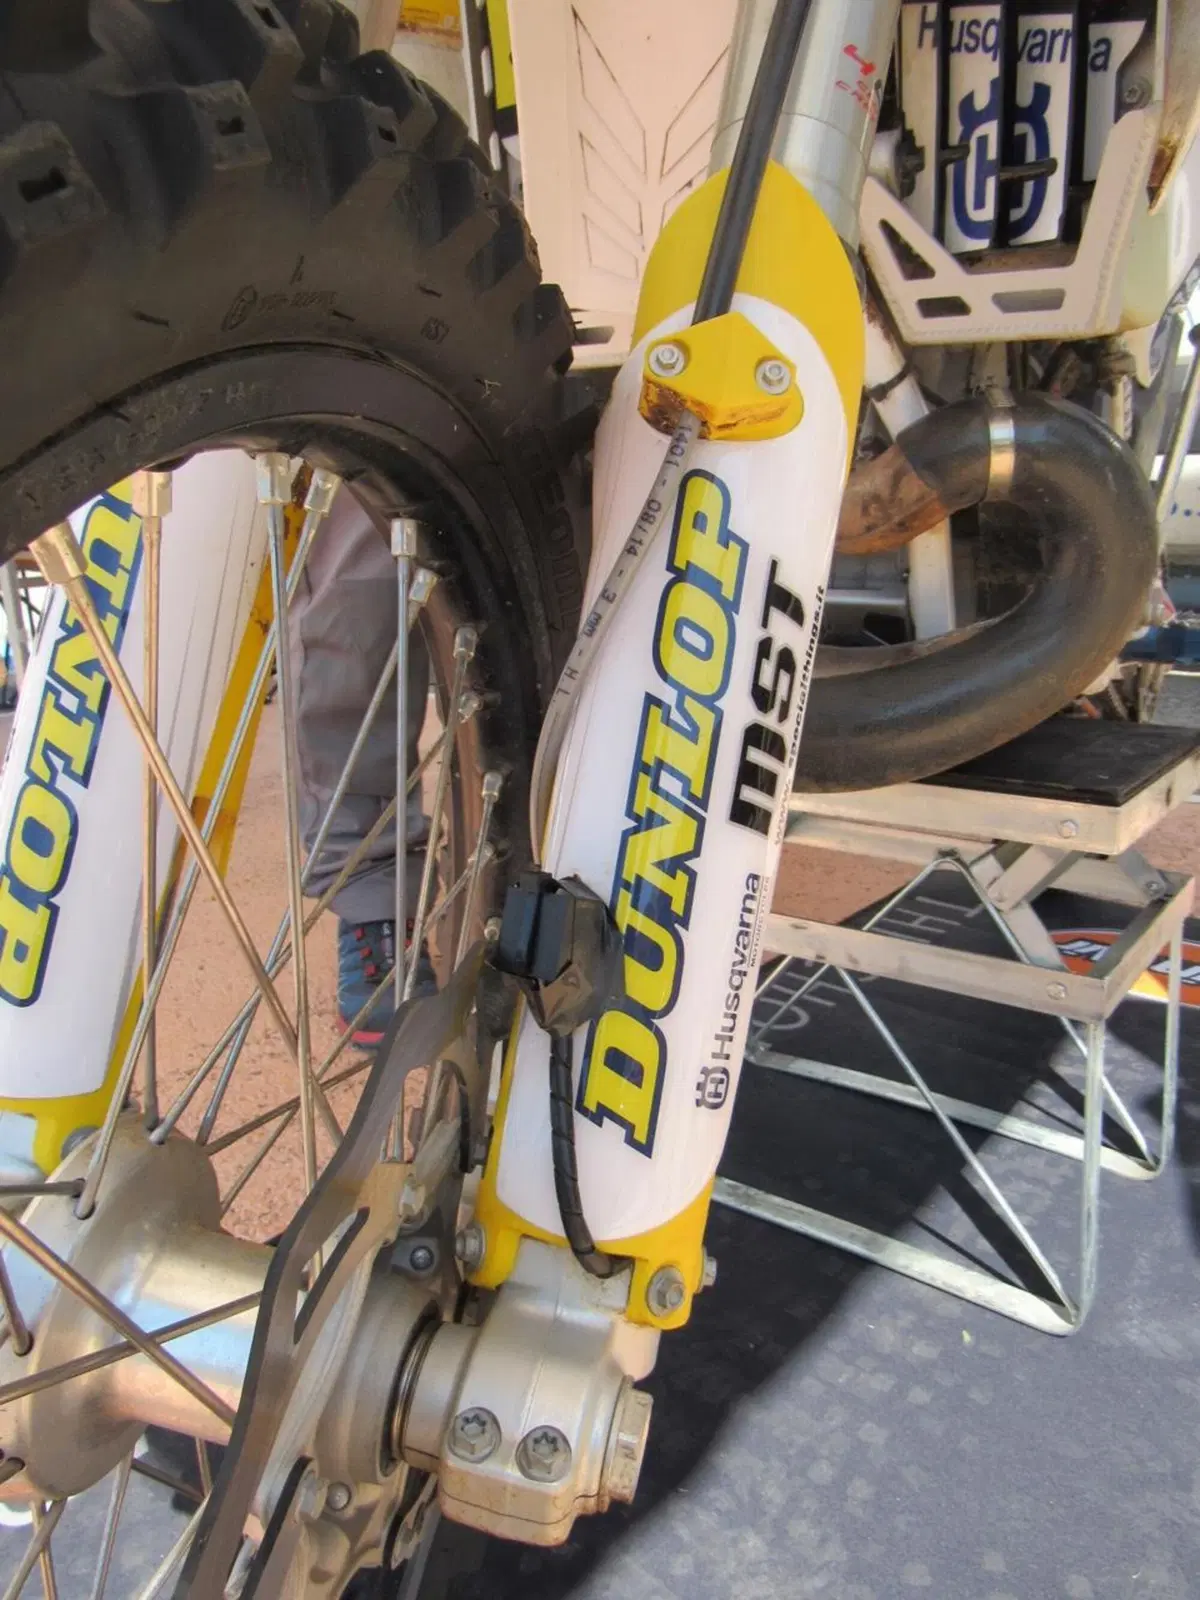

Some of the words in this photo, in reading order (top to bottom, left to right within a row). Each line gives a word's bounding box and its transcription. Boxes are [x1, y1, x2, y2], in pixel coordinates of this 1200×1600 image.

[623, 498, 661, 557] 08/14
[582, 612, 602, 639] mm
[601, 586, 618, 606] 3
[0, 472, 145, 1008] UNLOP
[574, 467, 750, 1160] DUNLOP
[711, 872, 761, 1060] Husqvarna
